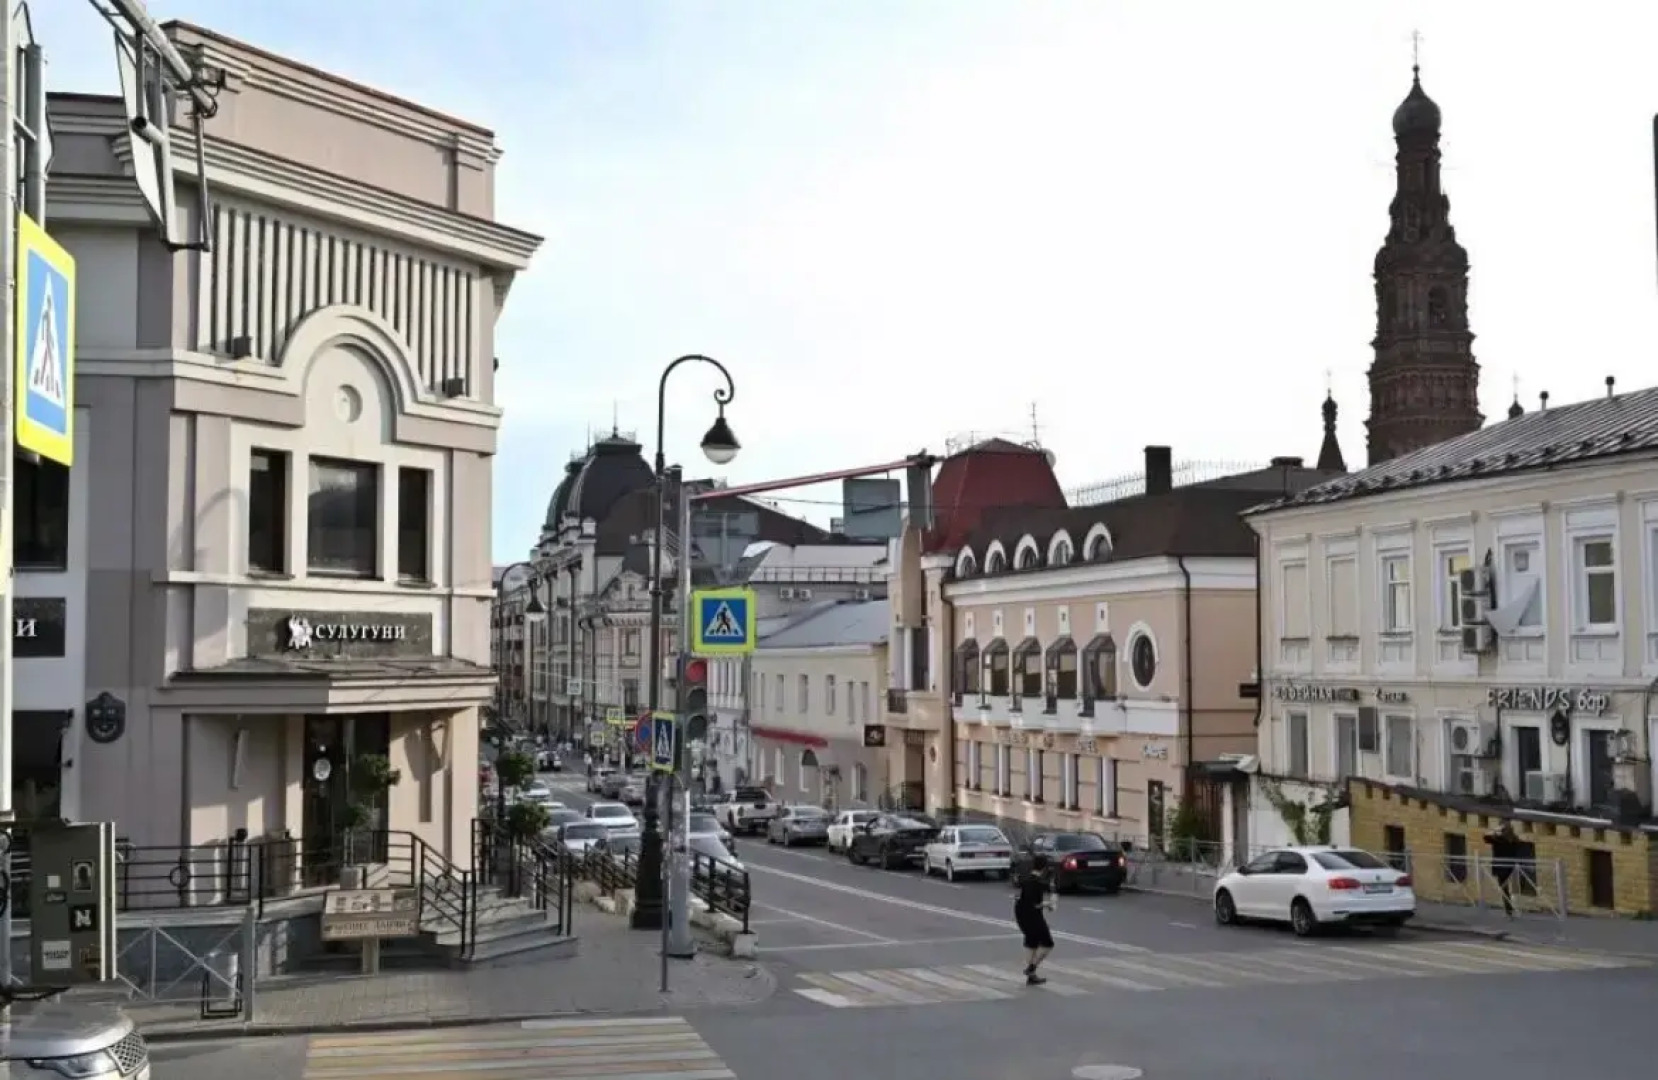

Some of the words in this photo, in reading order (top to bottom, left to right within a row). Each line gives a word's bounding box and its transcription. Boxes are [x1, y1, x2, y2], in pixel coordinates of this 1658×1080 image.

[315, 624, 405, 639] СУЛУГУНИ
[1487, 688, 1570, 710] FRIENDS
[1578, 689, 1607, 716] бар
